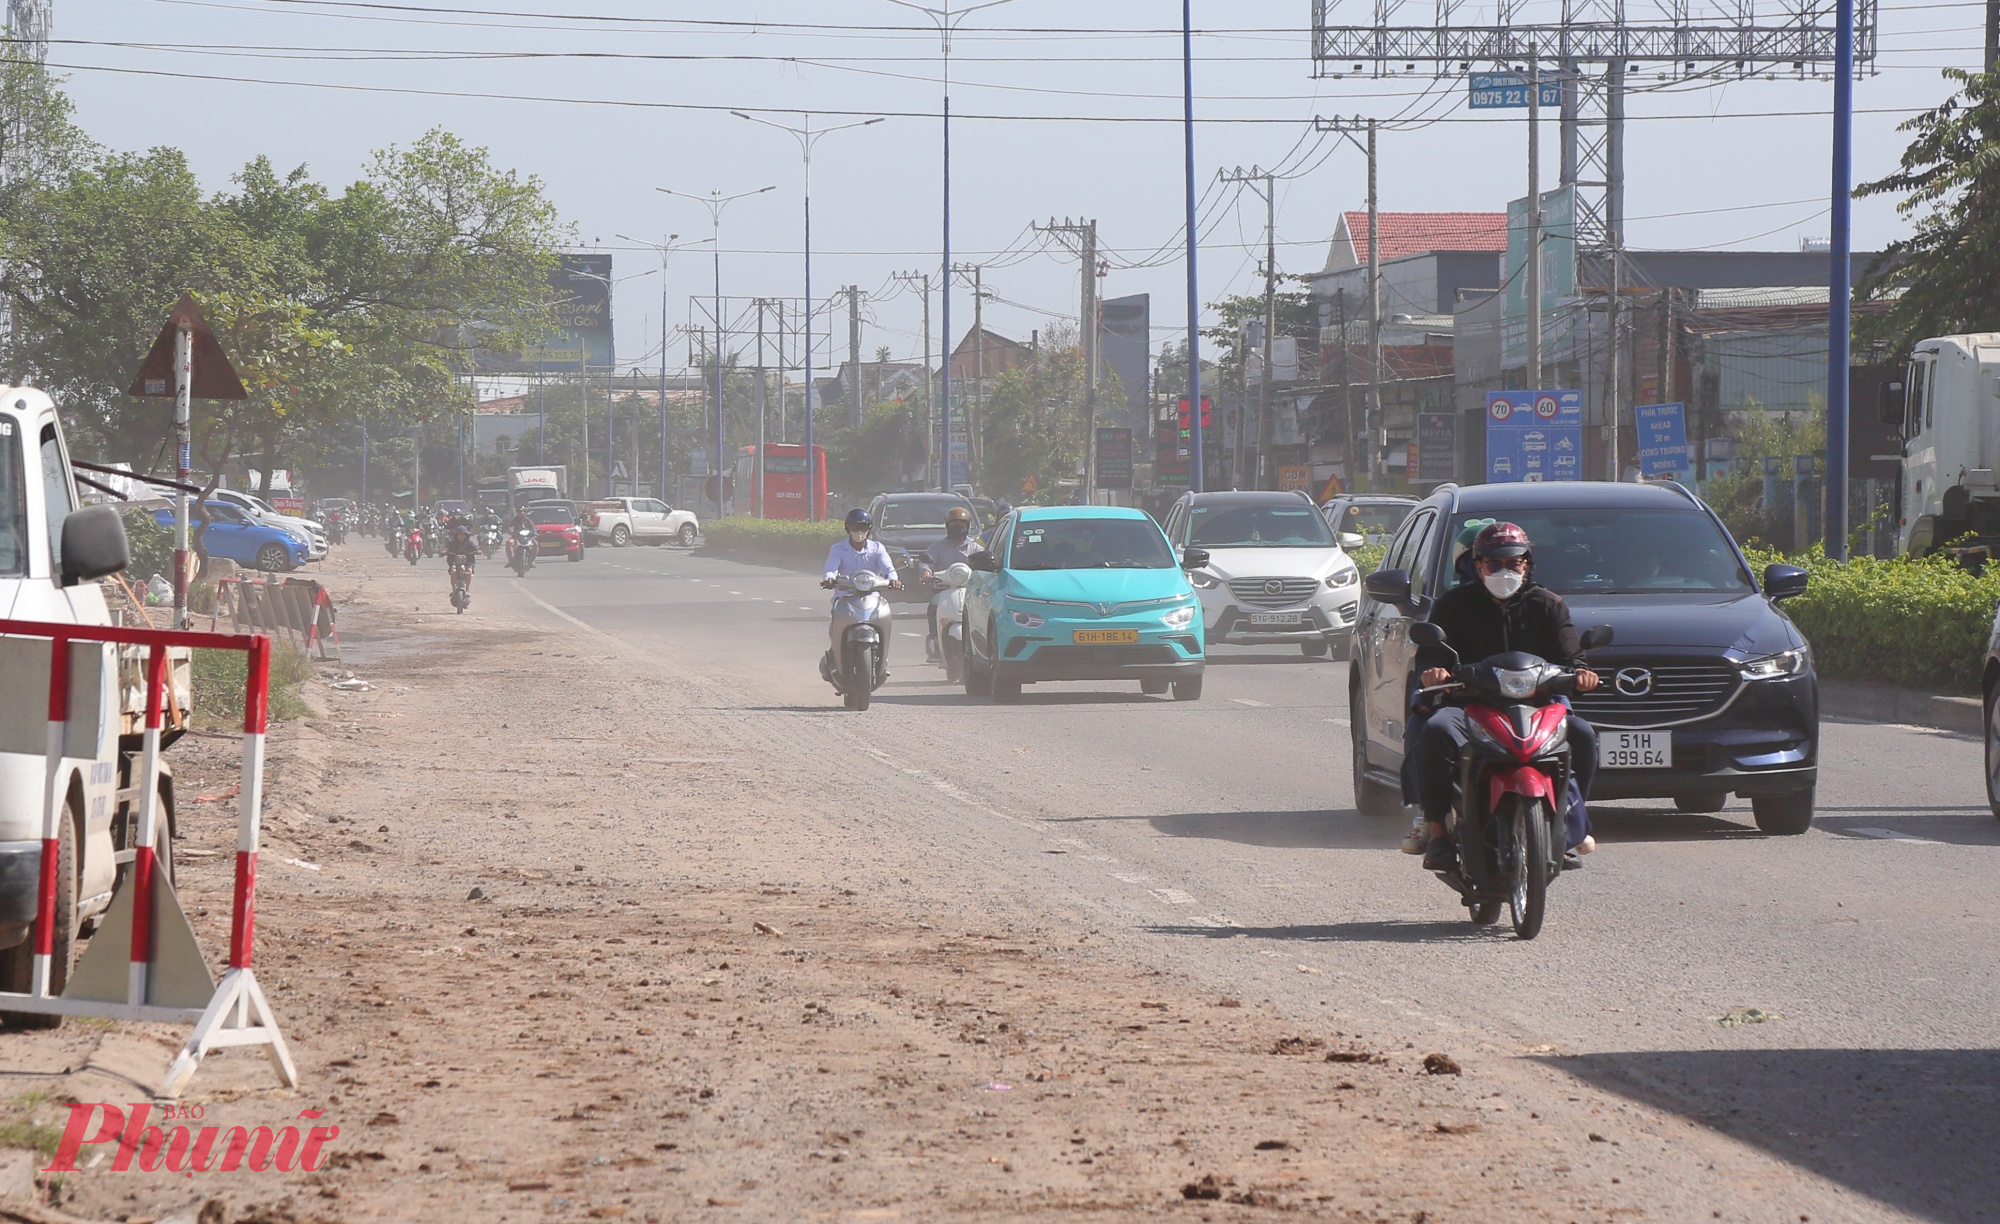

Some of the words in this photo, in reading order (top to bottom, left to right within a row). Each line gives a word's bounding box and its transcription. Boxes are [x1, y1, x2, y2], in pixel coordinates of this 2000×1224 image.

[1473, 91, 1502, 105] 0975
[1506, 90, 1521, 104] 22
[1542, 89, 1557, 103] 67
[1494, 404, 1507, 415] 70
[1539, 402, 1553, 413] 60
[1650, 421, 1671, 430] AHEAD
[1652, 460, 1677, 469] WORKS
[1620, 733, 1651, 749] 51H
[1607, 750, 1664, 765] 399.64
